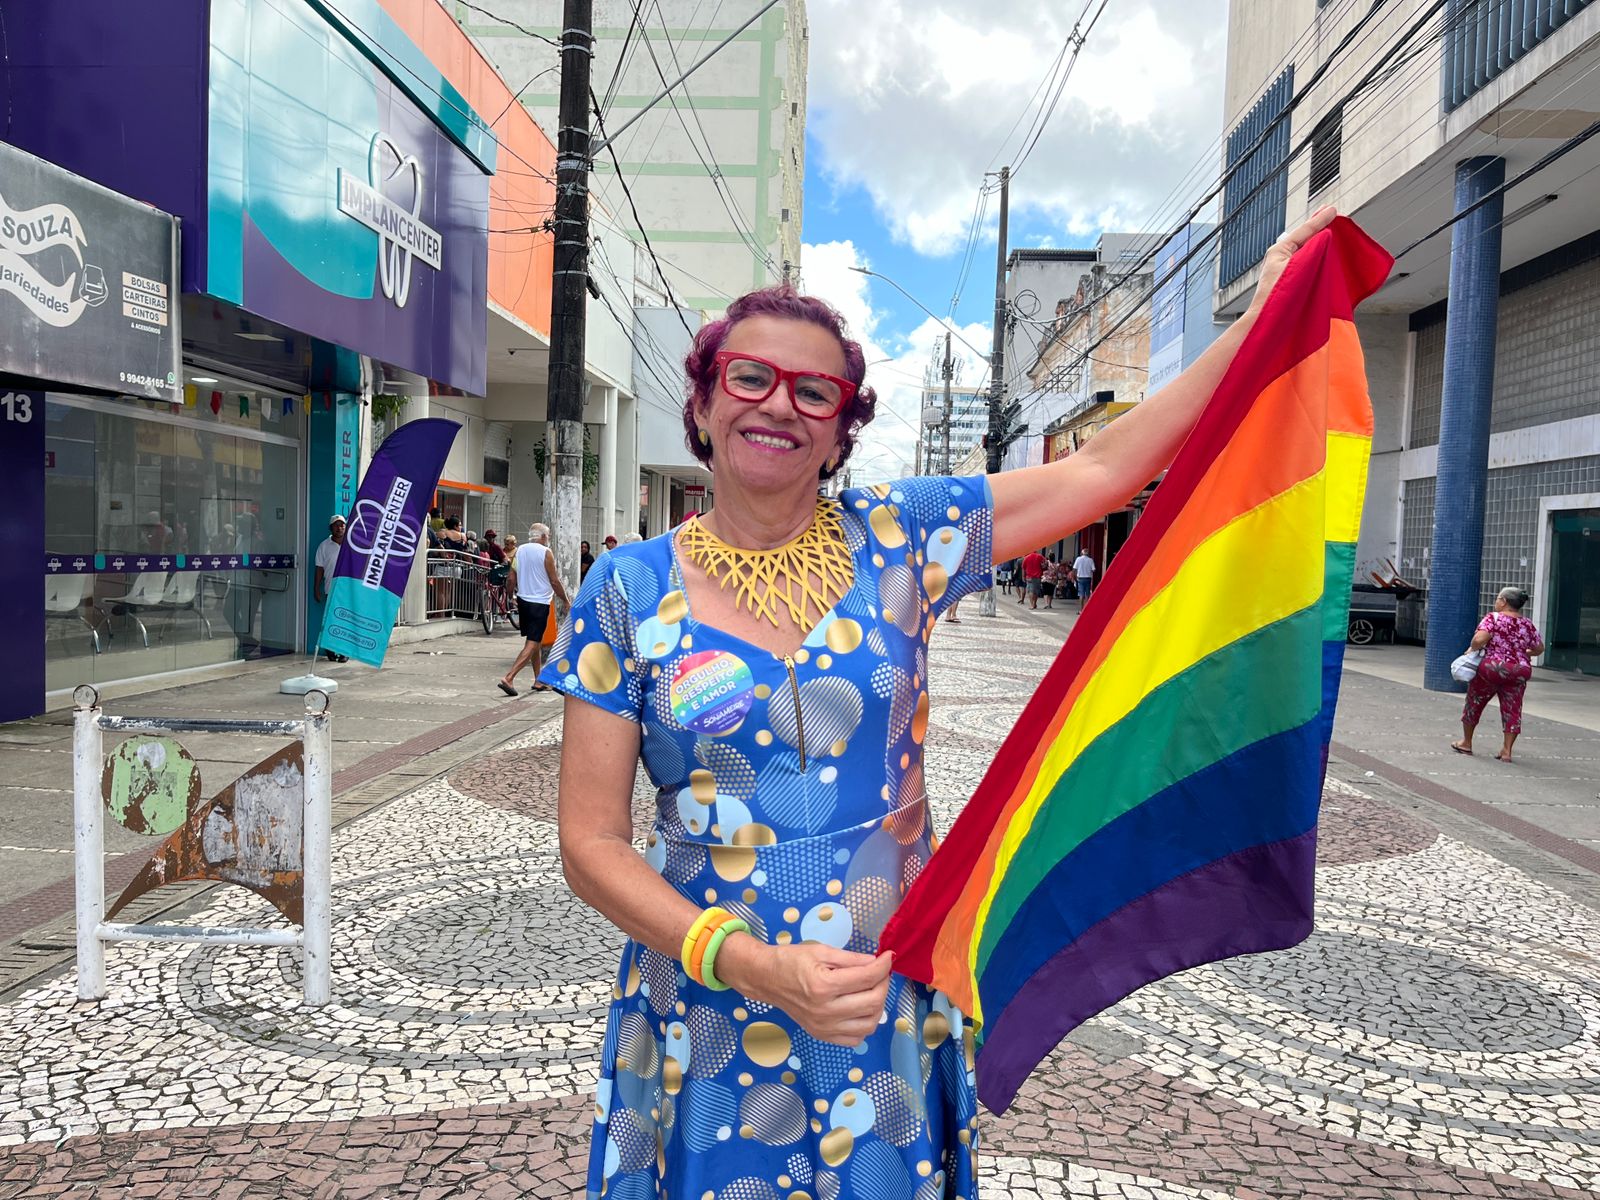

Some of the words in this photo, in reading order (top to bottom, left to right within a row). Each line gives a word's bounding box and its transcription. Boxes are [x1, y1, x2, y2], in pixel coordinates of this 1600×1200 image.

[2, 215, 73, 246] SOUZA
[343, 179, 440, 262] IMPLANCENTER
[124, 290, 166, 309] CARTEIRAS
[131, 276, 161, 293] BOLSAS
[131, 307, 160, 322] CINTOS
[120, 372, 126, 382] 9
[1, 391, 33, 423] 13
[366, 481, 410, 587] IMPLANCENTER
[682, 668, 736, 704] RESPEITO
[691, 700, 701, 711] E
[702, 680, 737, 705] AMOR
